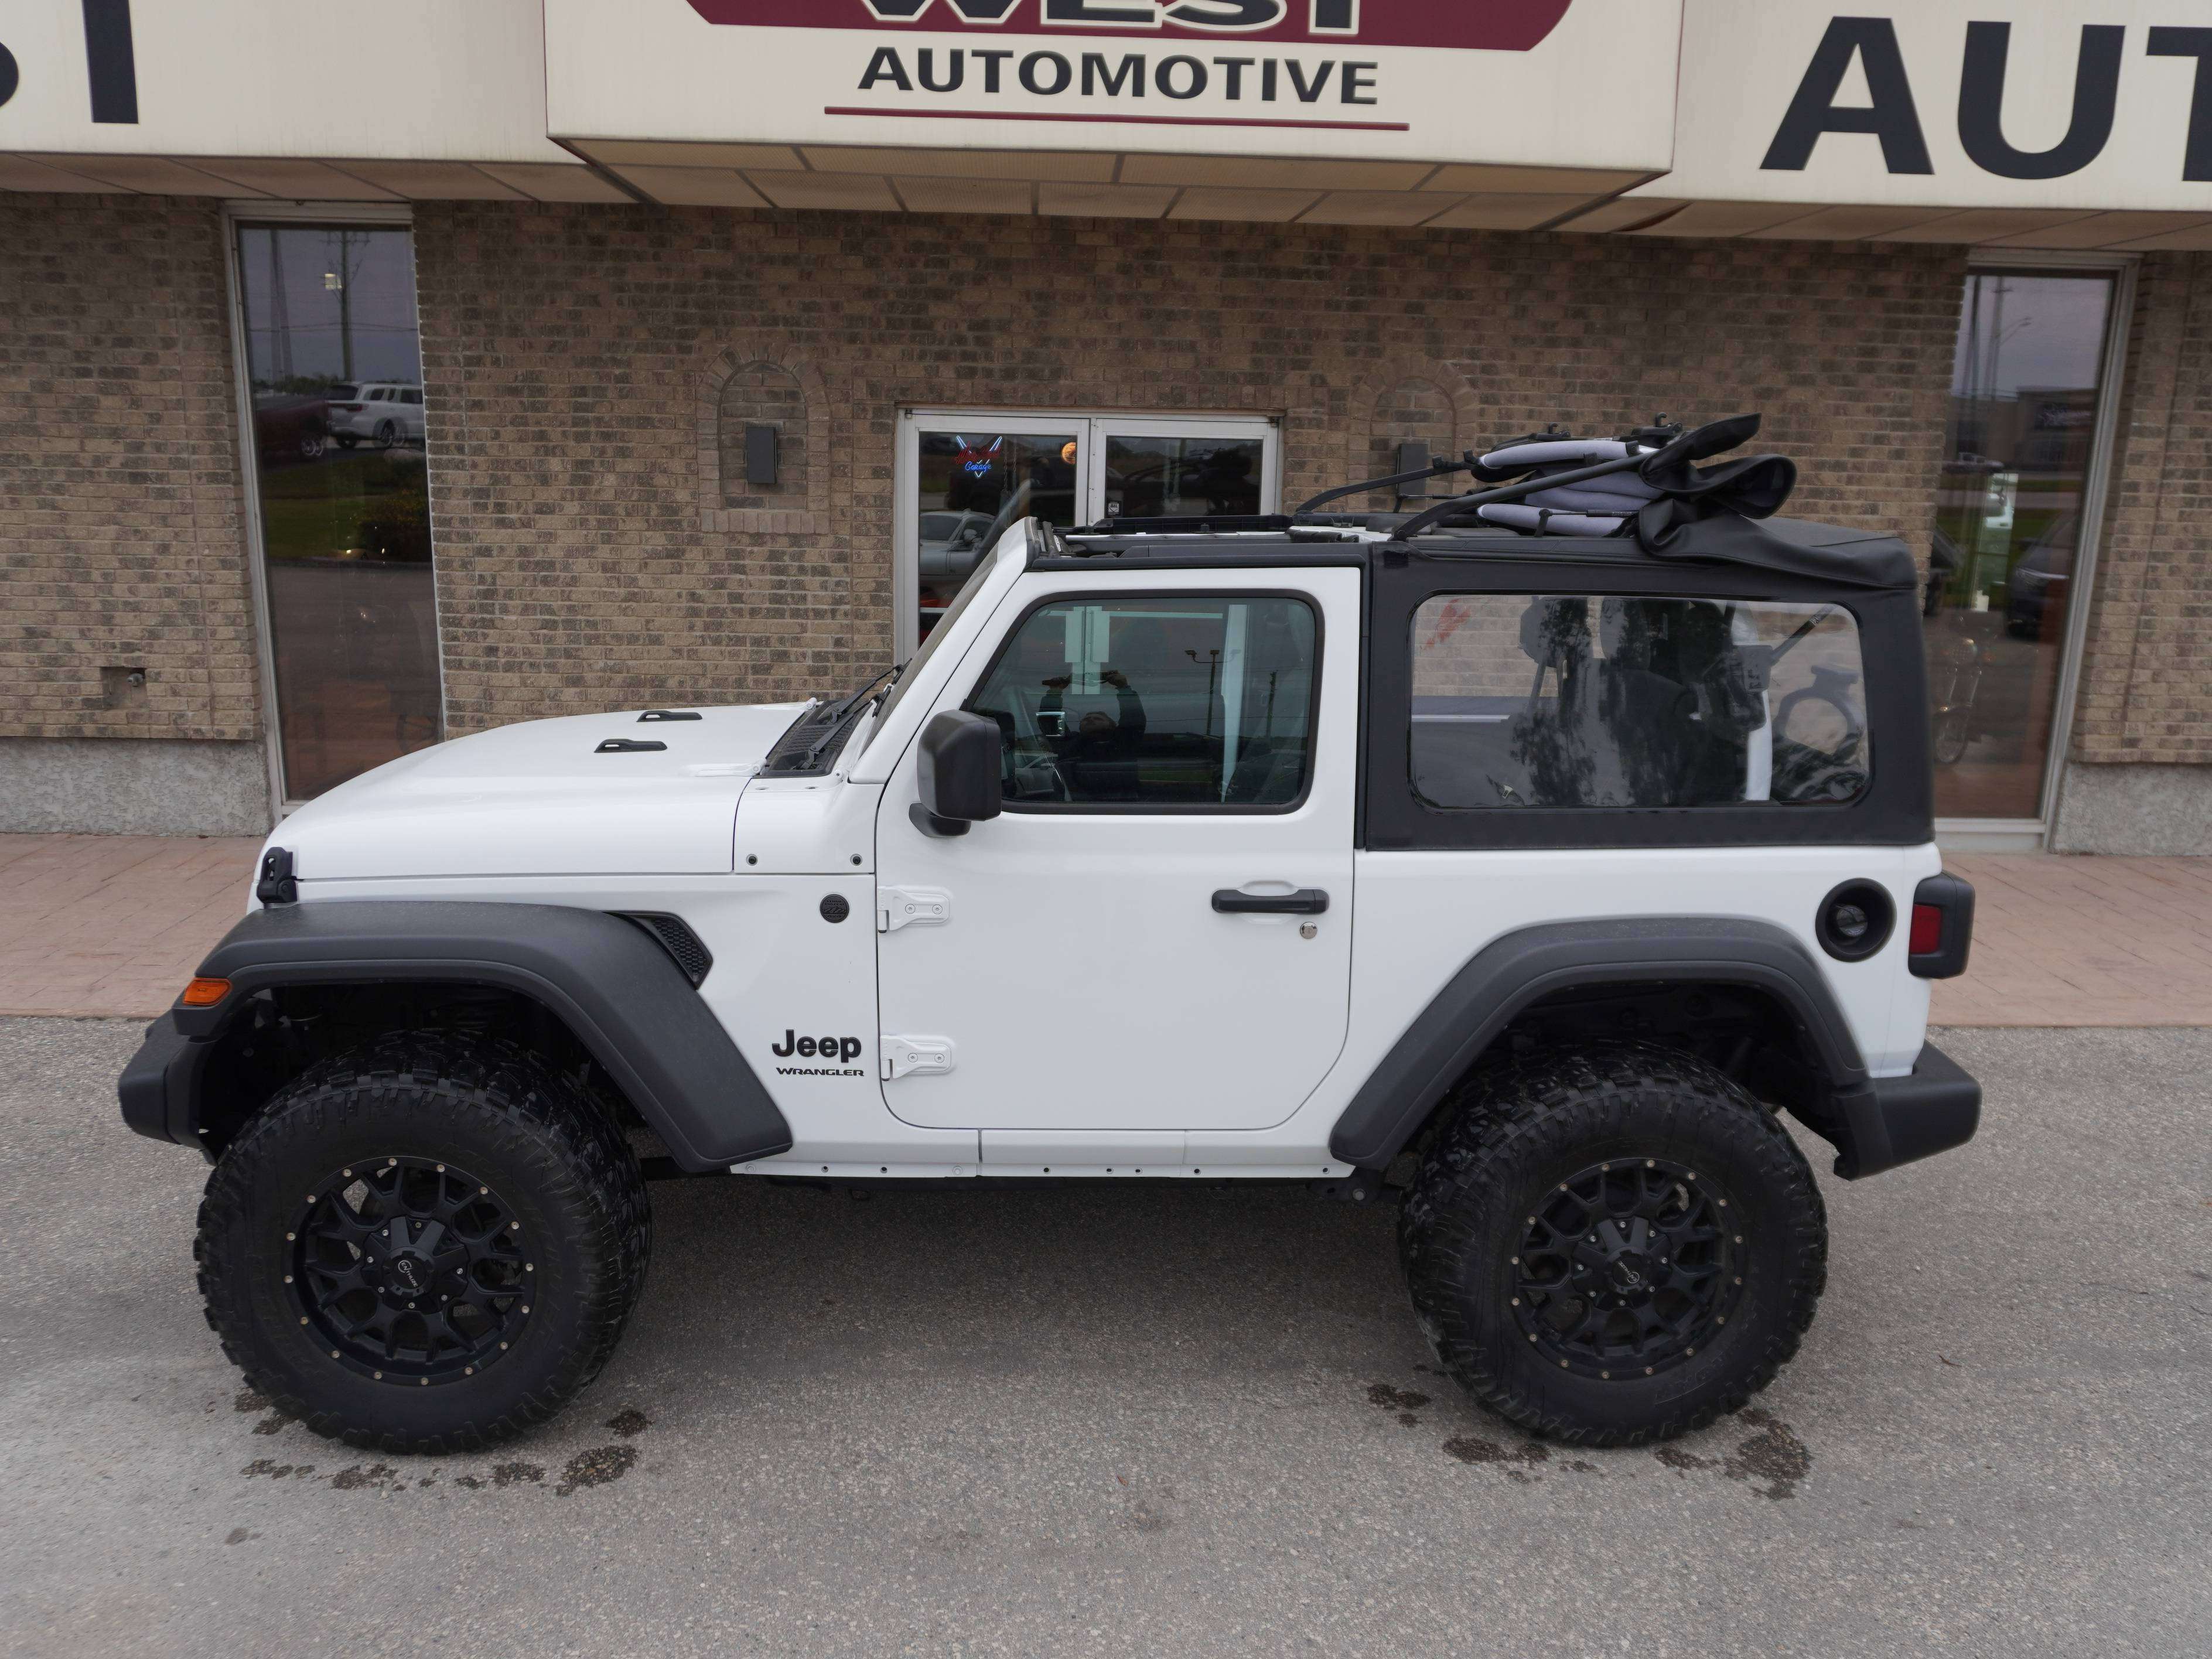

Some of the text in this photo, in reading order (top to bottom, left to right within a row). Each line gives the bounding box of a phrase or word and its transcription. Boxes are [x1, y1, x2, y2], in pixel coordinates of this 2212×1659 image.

[857, 46, 1378, 105] AUTOMOTIVE
[772, 1029, 862, 1063] Jeep
[776, 1067, 865, 1077] WRANGLER
